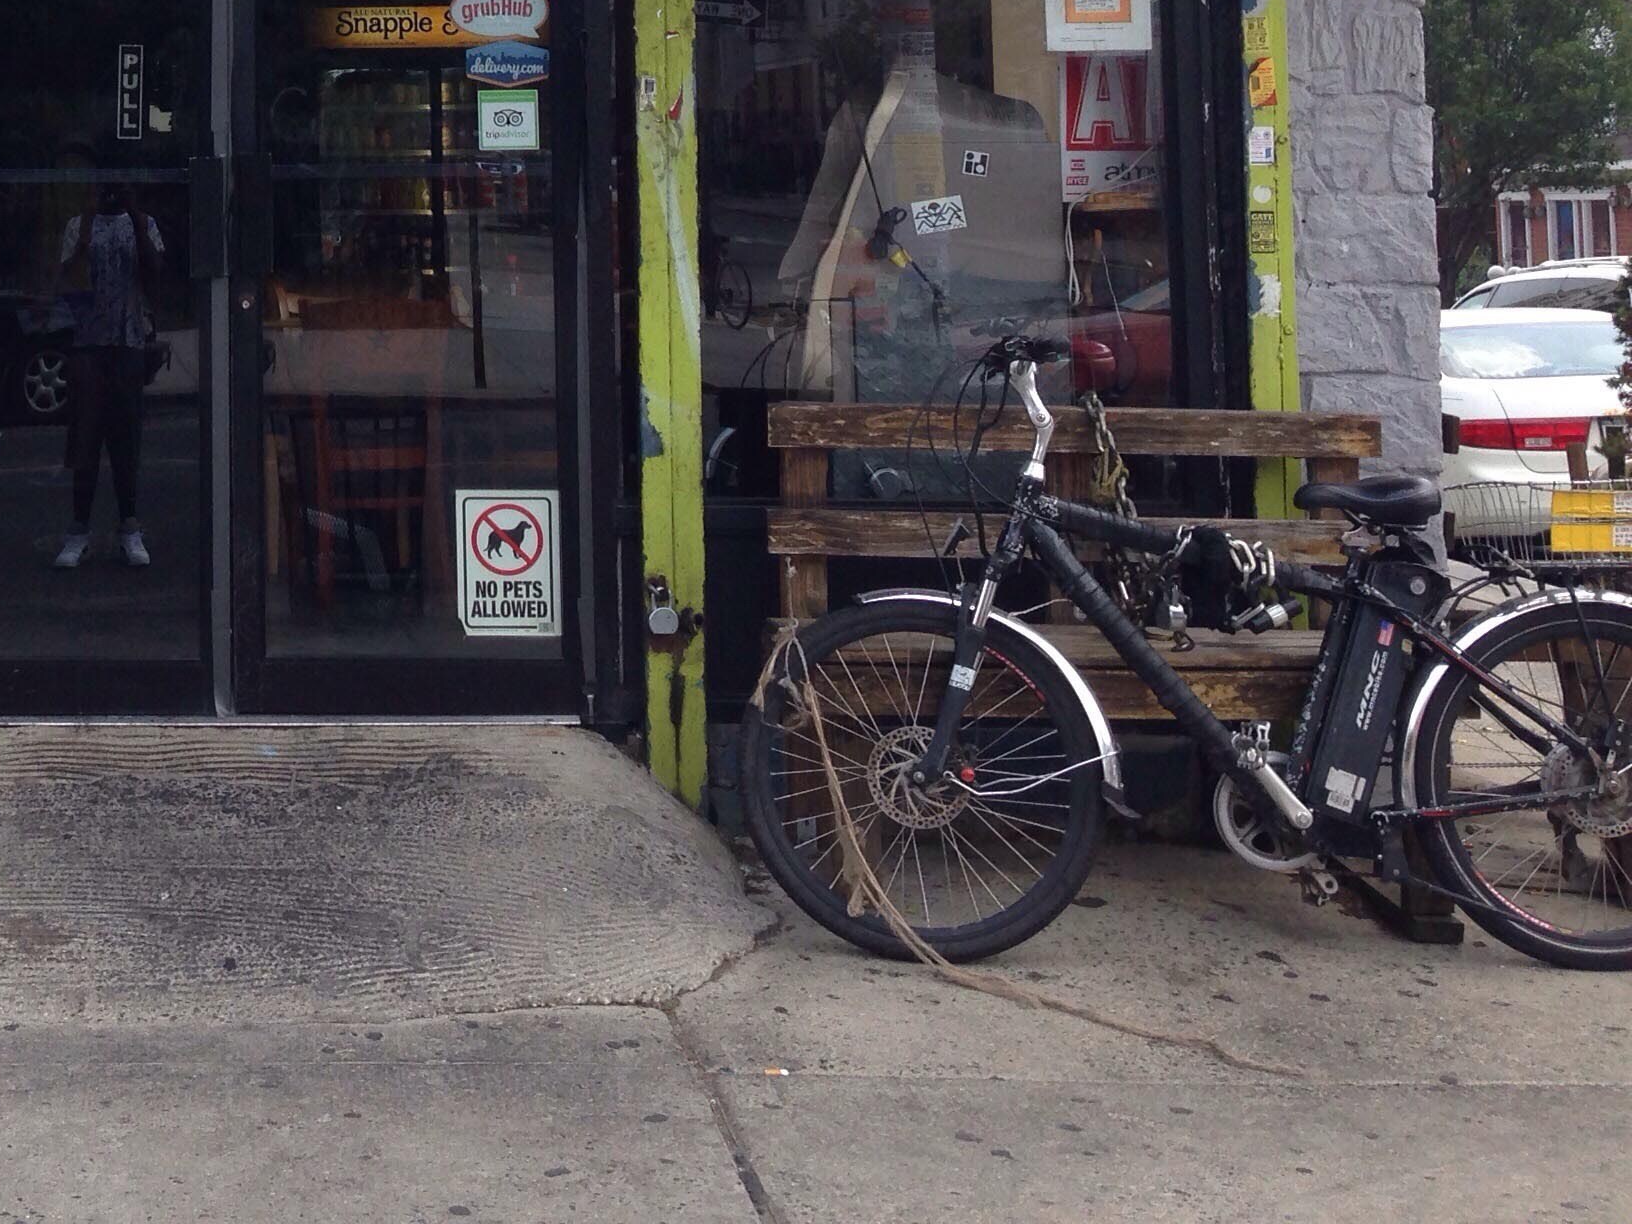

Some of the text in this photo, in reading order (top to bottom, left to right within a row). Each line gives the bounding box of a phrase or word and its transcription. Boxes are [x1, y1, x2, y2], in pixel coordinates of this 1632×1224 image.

[336, 11, 432, 39] Snapple
[470, 57, 544, 80] delivery.com
[123, 54, 138, 128] PULL
[475, 581, 543, 598] NO PETS
[471, 600, 548, 618] ALLOWED
